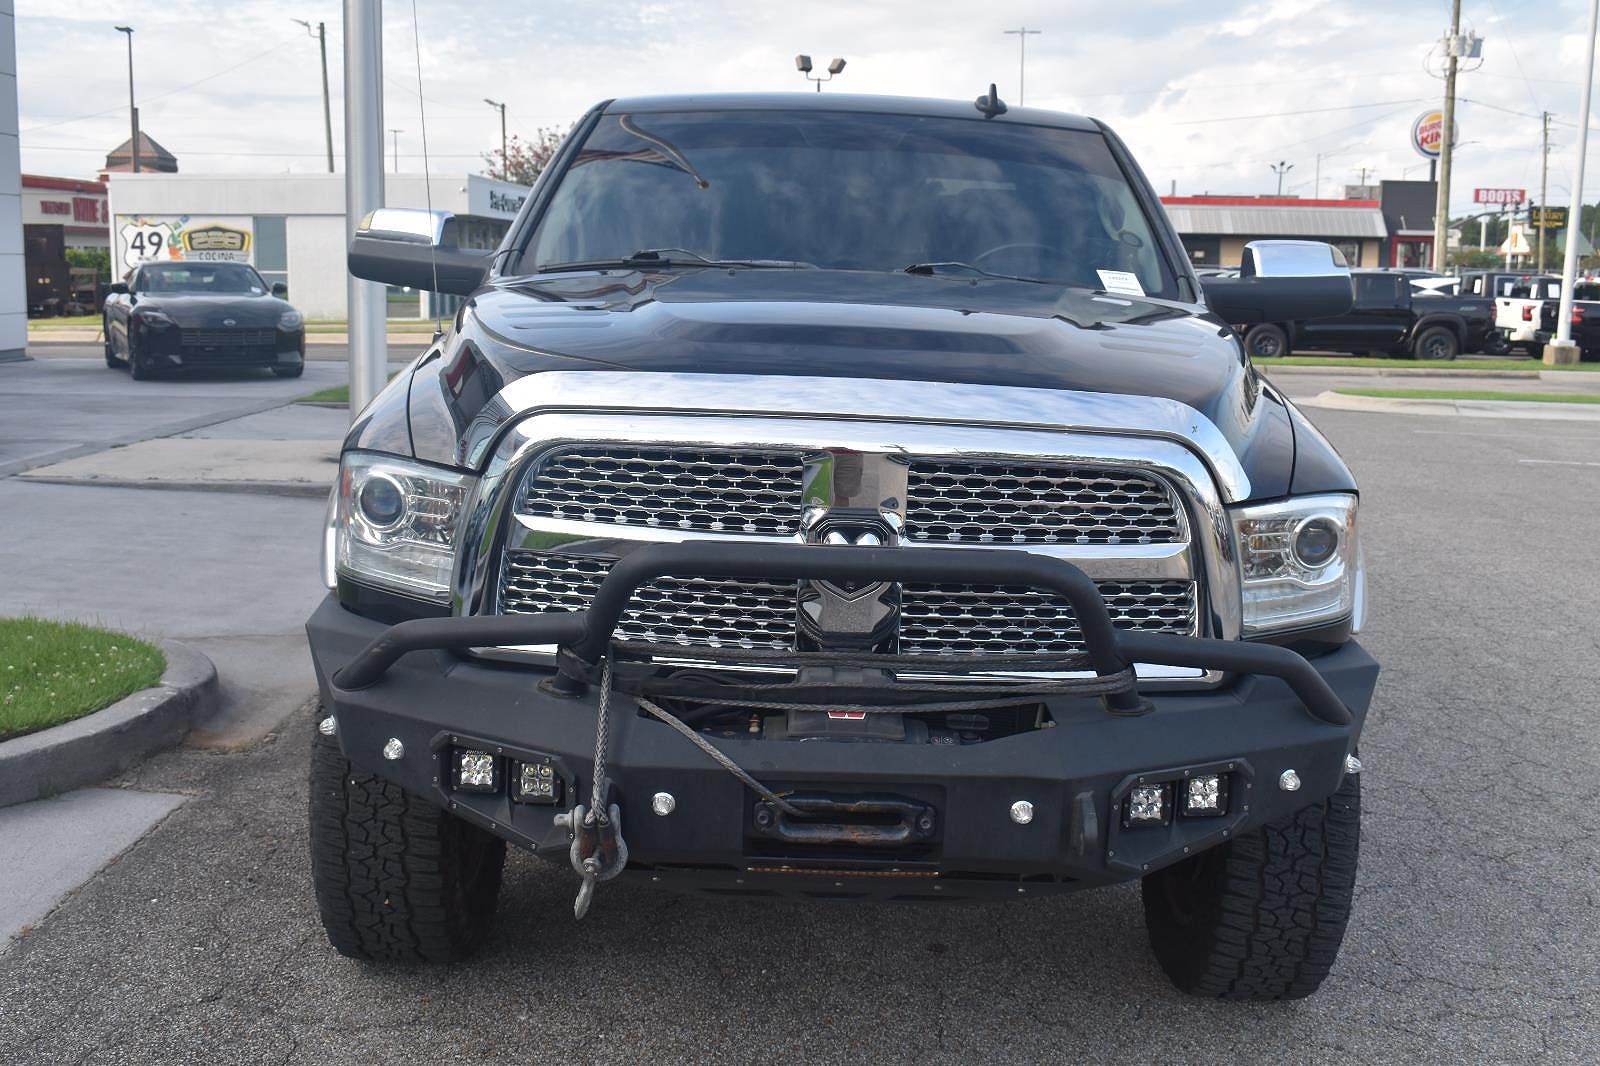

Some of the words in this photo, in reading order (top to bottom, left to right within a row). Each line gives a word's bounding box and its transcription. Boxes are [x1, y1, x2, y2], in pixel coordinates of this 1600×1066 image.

[1419, 121, 1442, 135] BURG
[1420, 131, 1442, 147] KIN
[1478, 190, 1520, 202] BOOTS
[131, 231, 163, 256] 49
[199, 252, 235, 261] COCINA
